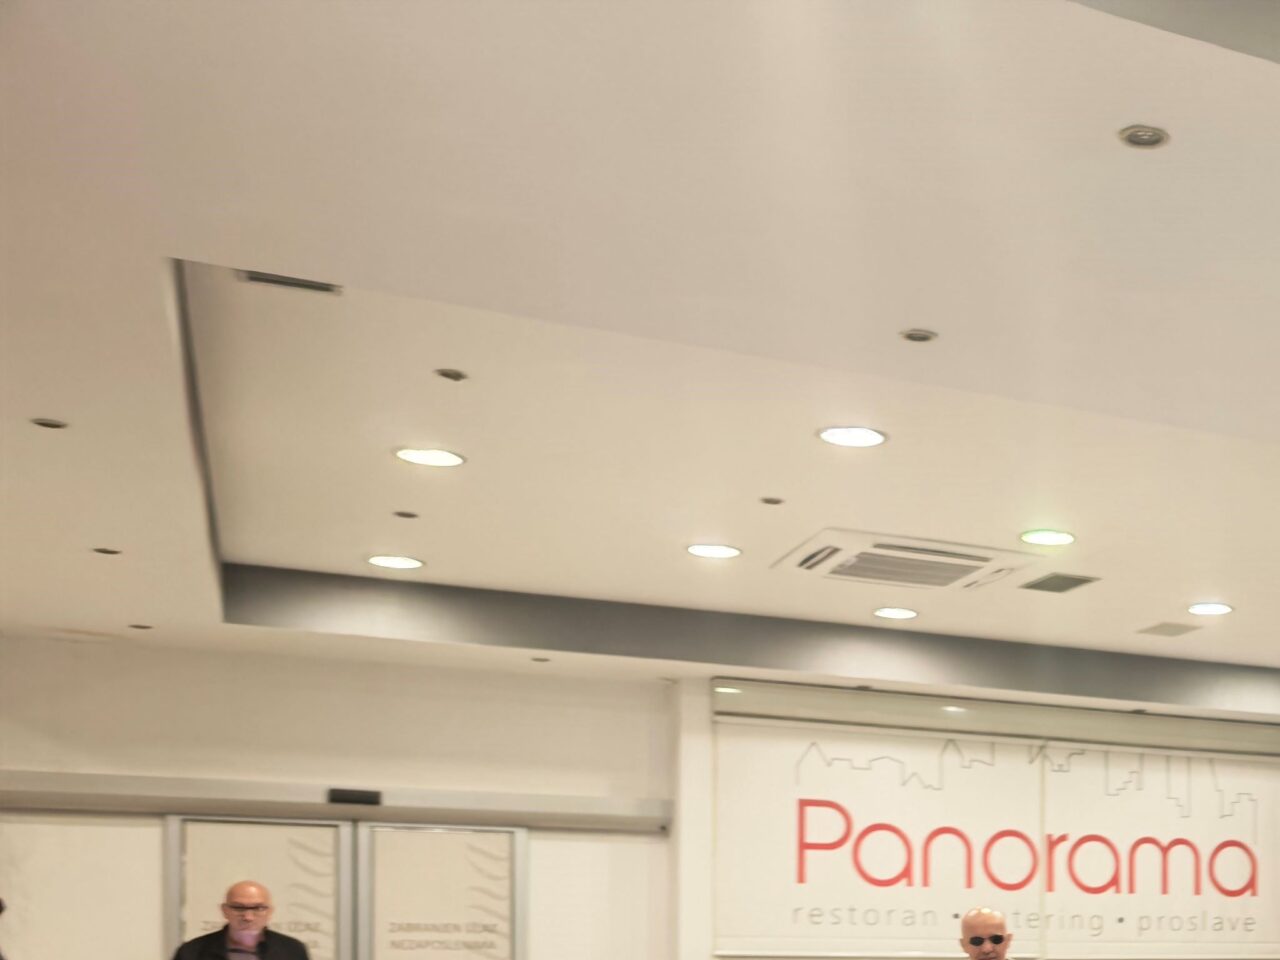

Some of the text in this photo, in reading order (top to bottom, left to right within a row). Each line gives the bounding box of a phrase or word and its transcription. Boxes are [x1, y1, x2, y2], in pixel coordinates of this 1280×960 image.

[795, 797, 1259, 898] Panorama
[791, 904, 1257, 937] restoran tering proslave
